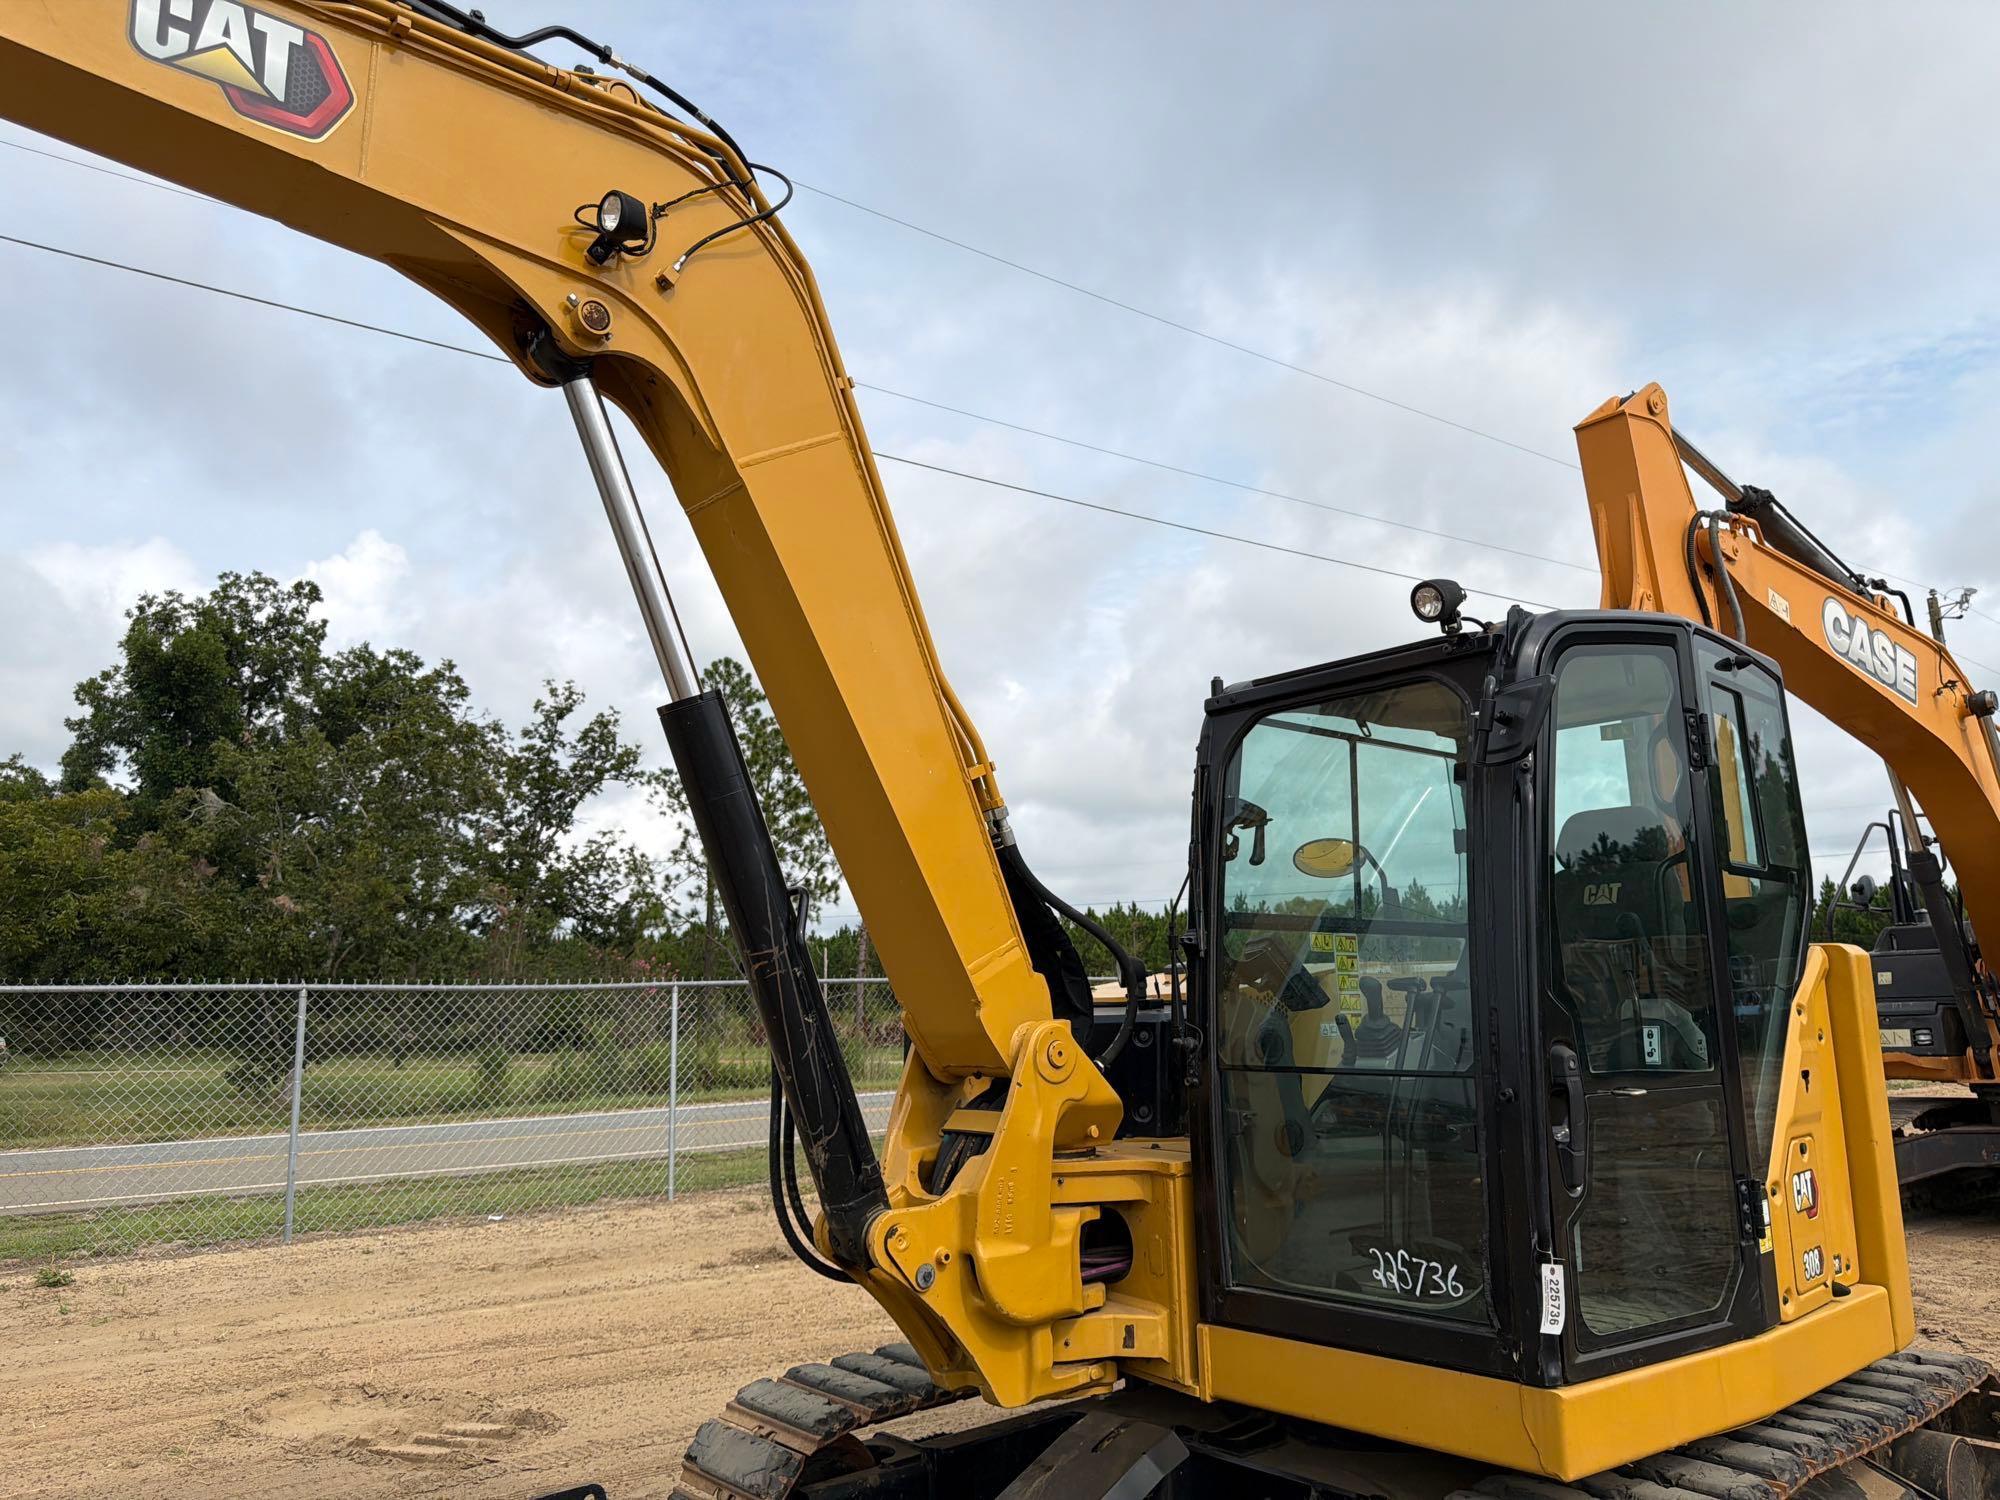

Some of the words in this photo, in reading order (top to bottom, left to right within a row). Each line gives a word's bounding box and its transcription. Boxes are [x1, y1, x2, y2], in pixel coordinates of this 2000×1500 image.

[134, 0, 304, 103] CAT
[1824, 598, 1917, 705] CASE
[1583, 882, 1622, 905] CAT
[1792, 1170, 1814, 1212] CAT
[1369, 1248, 1464, 1298] 225736
[1803, 1248, 1821, 1280] 308
[1549, 1278, 1561, 1326] 225736
